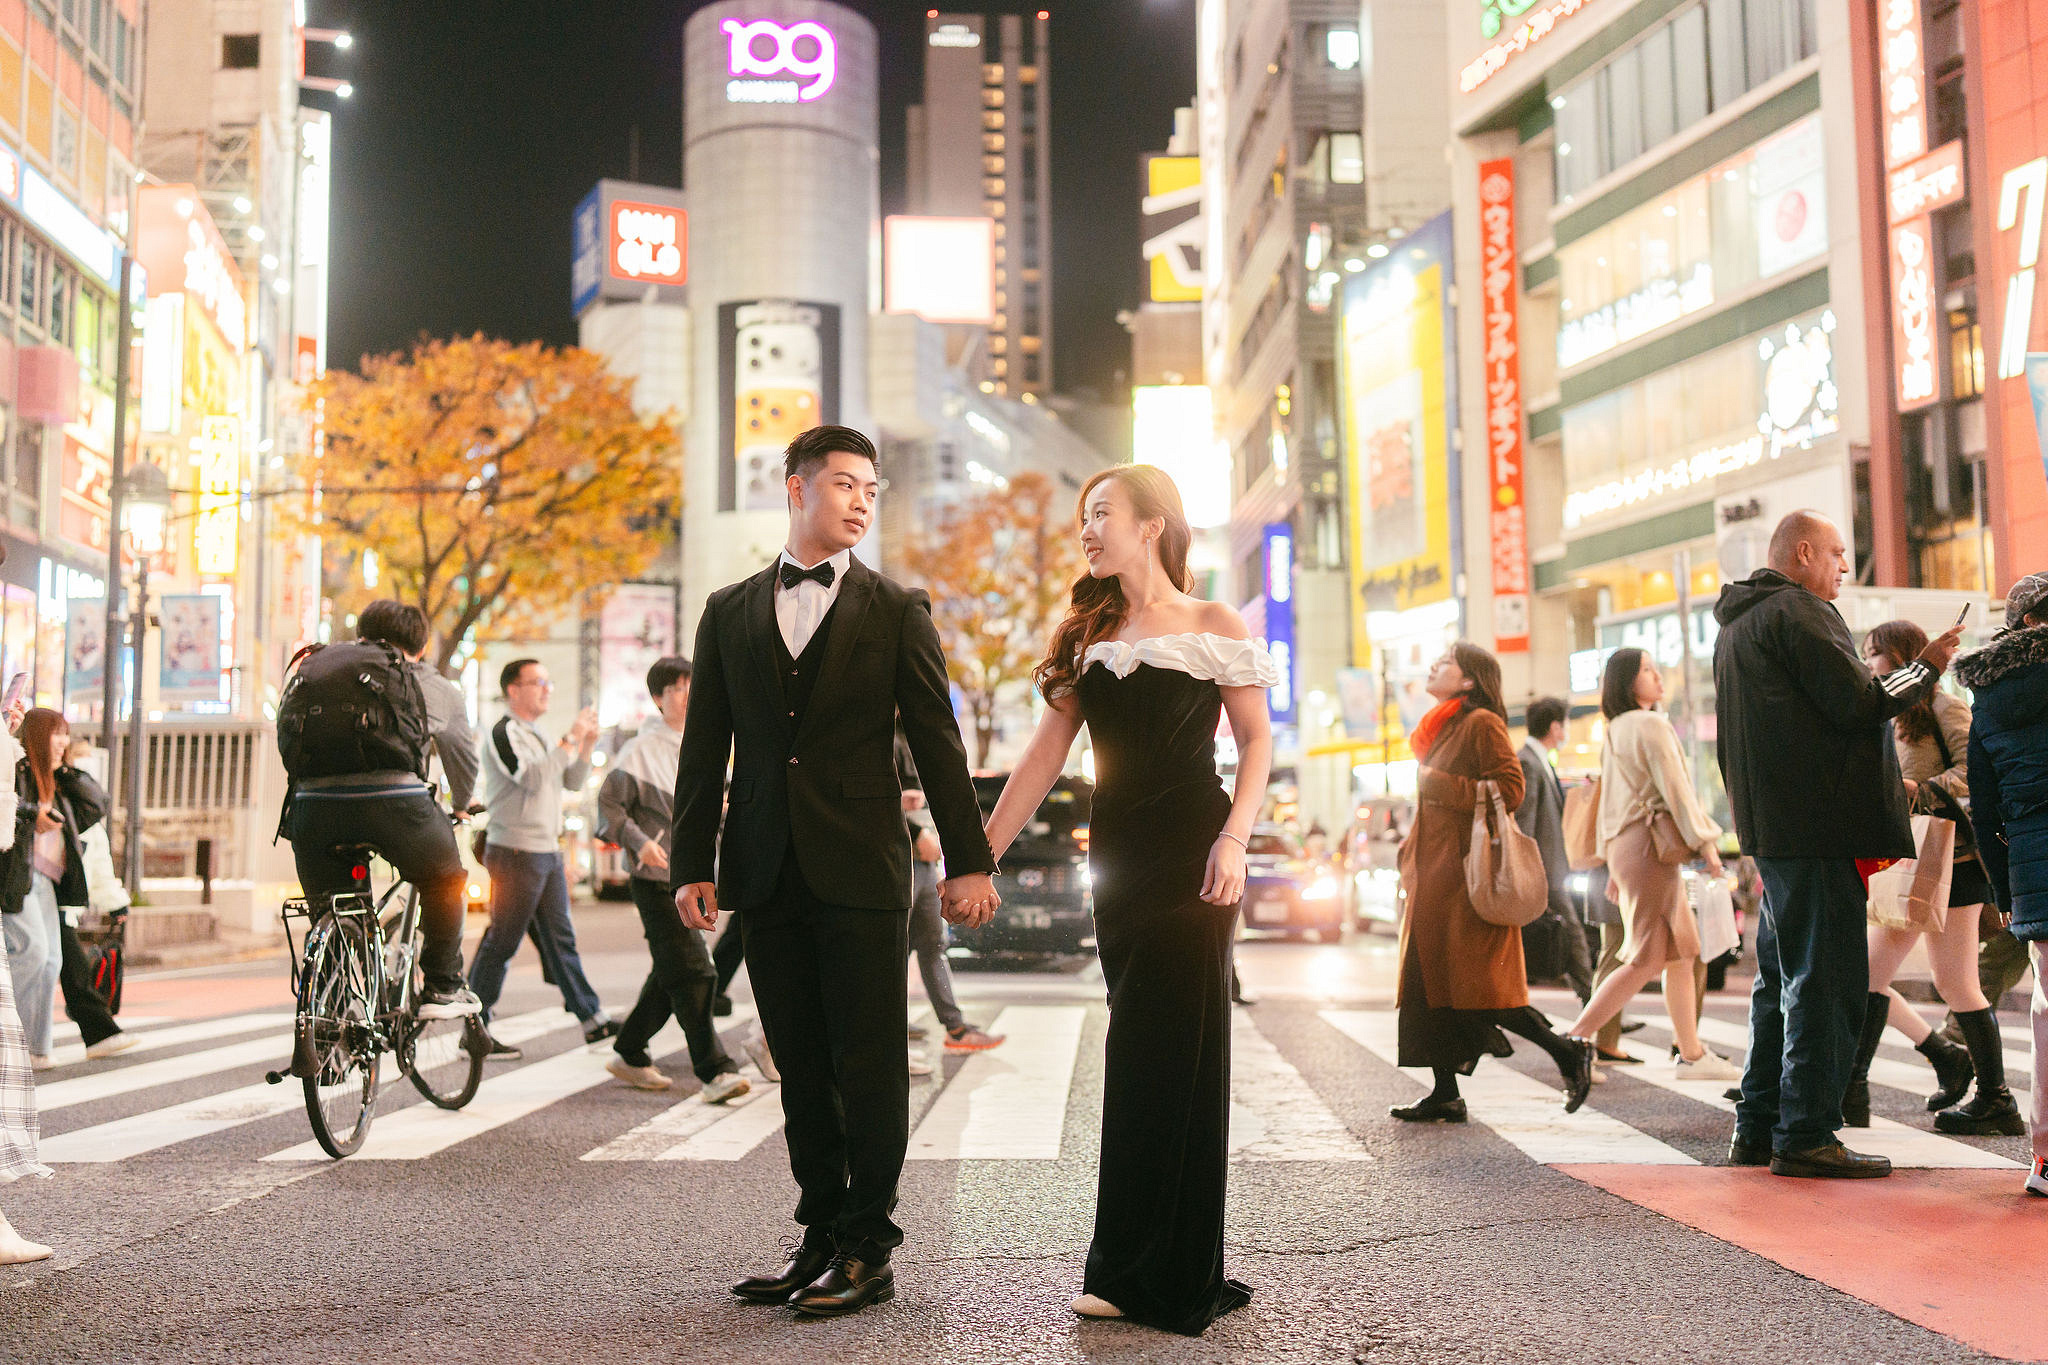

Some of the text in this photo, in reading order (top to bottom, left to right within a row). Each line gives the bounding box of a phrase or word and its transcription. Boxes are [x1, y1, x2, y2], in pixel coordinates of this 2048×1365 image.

[720, 18, 838, 102] 109
[617, 208, 676, 244] UNI
[617, 241, 681, 277] QLO
[1483, 204, 1518, 485] ウィンターフルーツギフト
